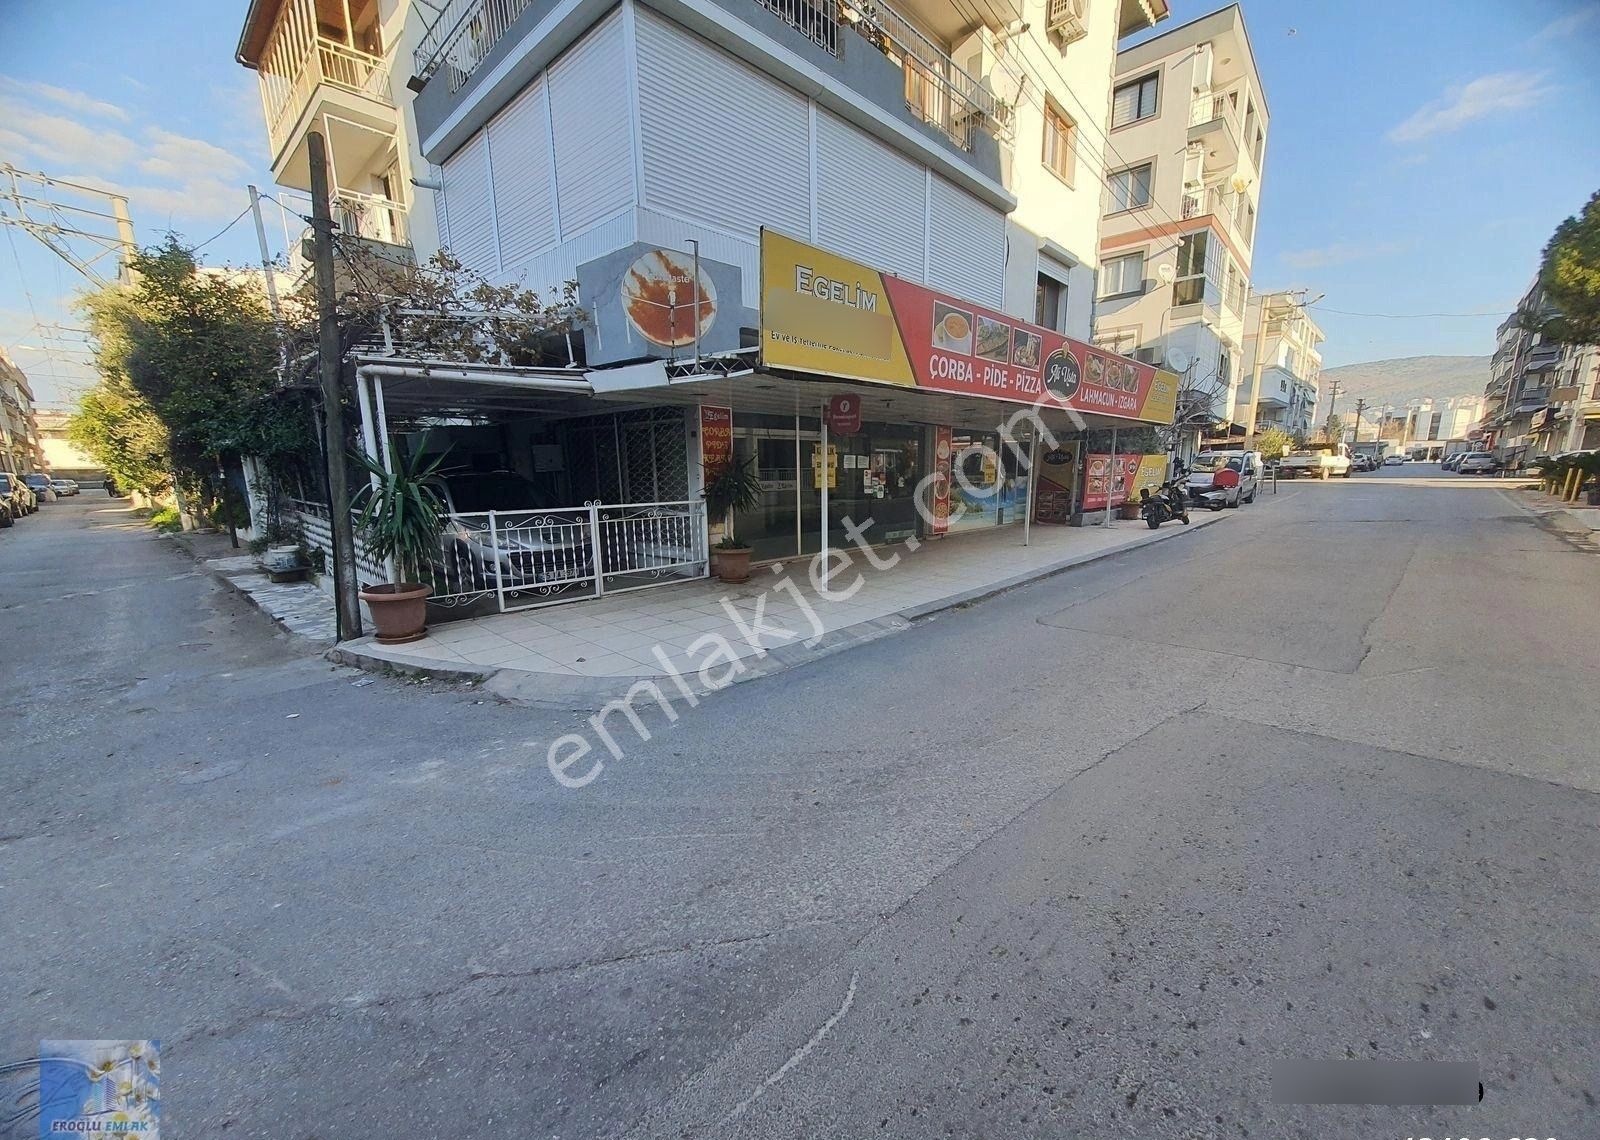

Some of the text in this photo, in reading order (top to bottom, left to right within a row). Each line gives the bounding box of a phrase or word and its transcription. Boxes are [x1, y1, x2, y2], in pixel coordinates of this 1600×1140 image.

[795, 264, 877, 312] EGELİM
[929, 354, 974, 383] ÇORBA
[983, 364, 1008, 389] PİDE
[1015, 371, 1042, 394] PİZZA
[1080, 387, 1114, 406] LAHMACUN
